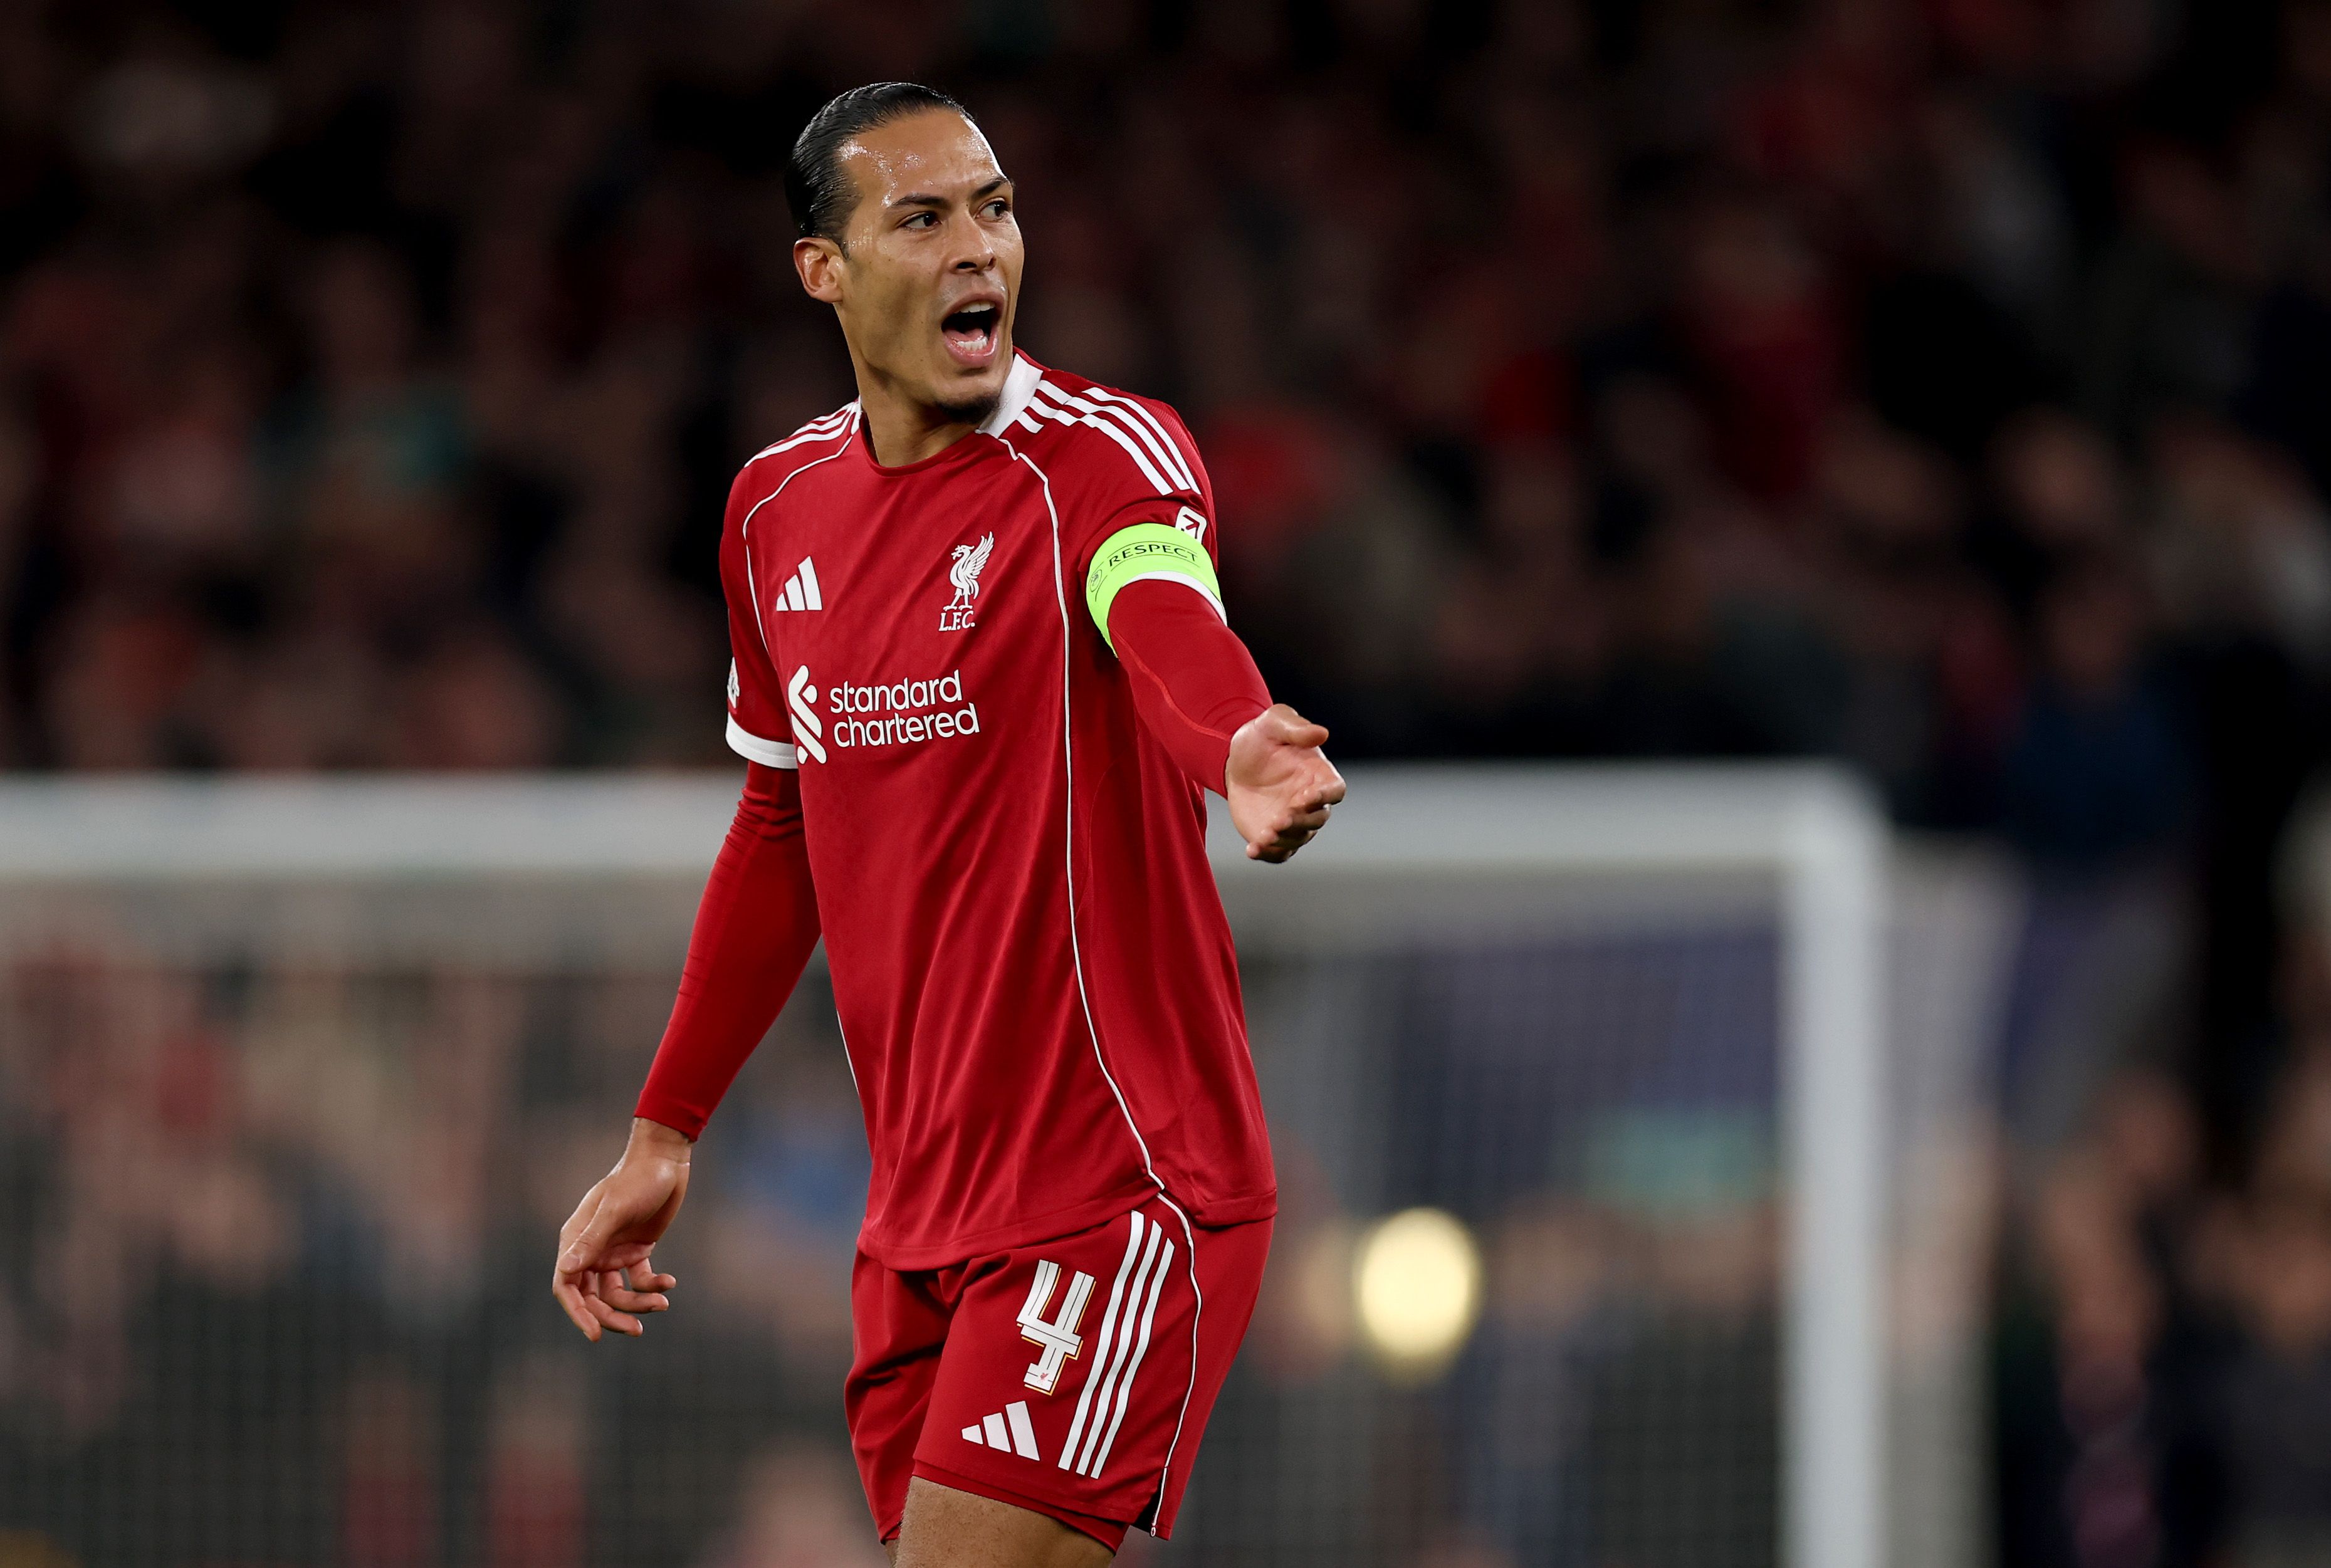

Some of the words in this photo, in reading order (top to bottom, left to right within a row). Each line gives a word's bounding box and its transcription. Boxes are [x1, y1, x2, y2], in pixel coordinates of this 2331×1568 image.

[1109, 544, 1198, 567] RESPECT
[830, 669, 963, 713] standard
[834, 703, 981, 748] chartered
[1016, 1259, 1096, 1396] 4
